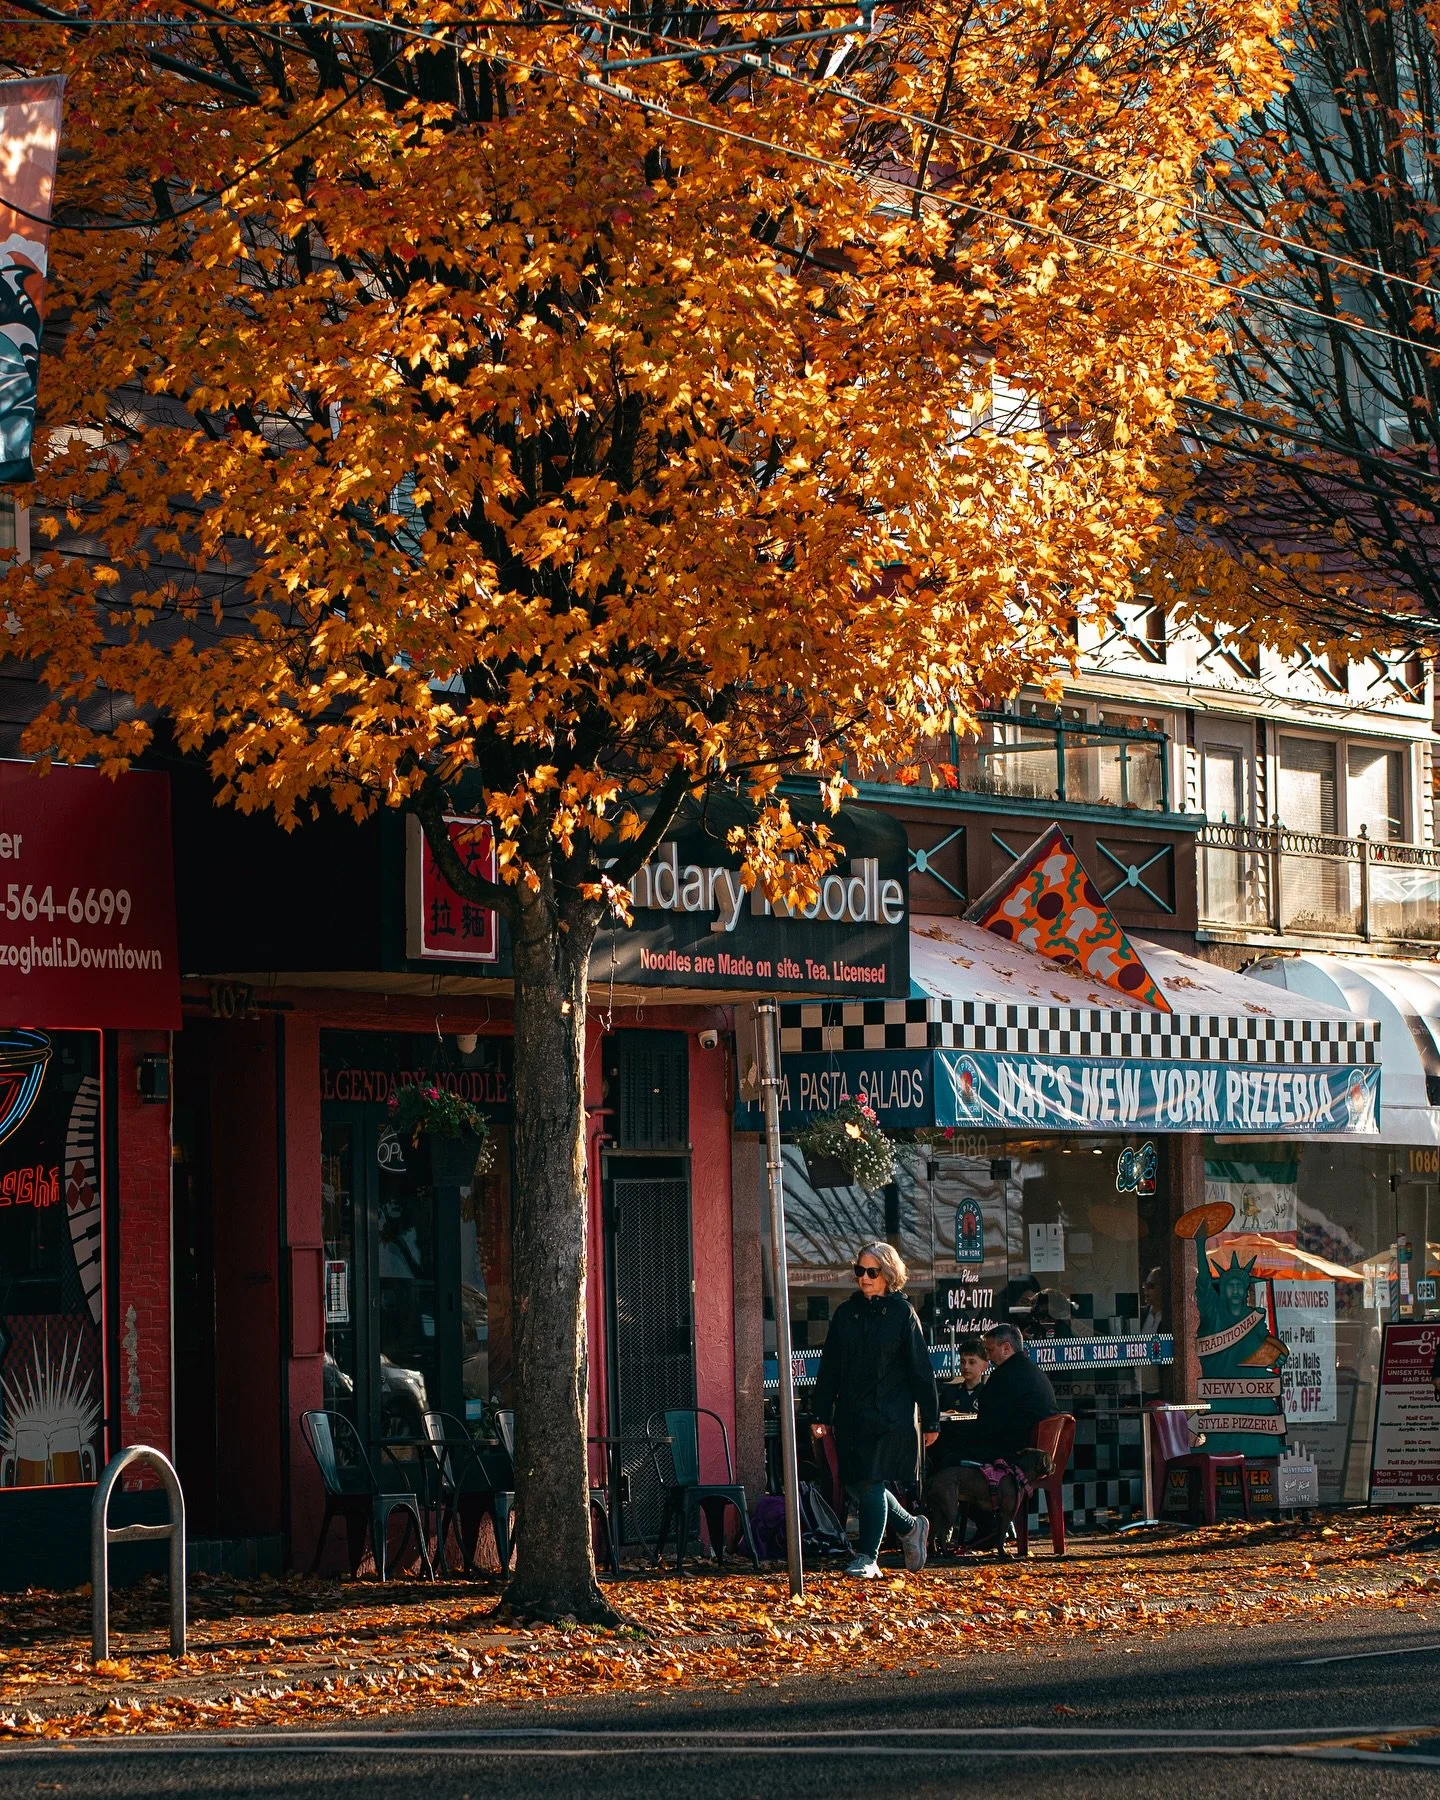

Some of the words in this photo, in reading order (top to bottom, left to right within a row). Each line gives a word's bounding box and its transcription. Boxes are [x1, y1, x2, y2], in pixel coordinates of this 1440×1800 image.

[640, 948, 691, 972] Noodles
[694, 956, 715, 974] are
[718, 954, 753, 977] Made
[756, 963, 771, 978] on
[777, 959, 803, 980] site.
[805, 959, 830, 981] Tea.
[833, 961, 885, 984] Licensed
[801, 1071, 848, 1111] PASTA
[859, 1068, 924, 1111] SALADS
[997, 1061, 1073, 1120] NAT'S
[1082, 1064, 1140, 1122] NEW
[1151, 1068, 1219, 1123] YORK
[1226, 1070, 1335, 1123] PIZZERIA
[1409, 1149, 1439, 1173] 1086
[962, 1269, 979, 1283] Phone
[948, 1289, 993, 1309] 642-0777
[1276, 1291, 1292, 1308] WAX
[1294, 1290, 1328, 1308] SERVICES
[1418, 1283, 1435, 1298] OPEN
[970, 1318, 981, 1332] End
[1199, 1314, 1257, 1353] TRADITIONAL
[1300, 1327, 1316, 1343] Pedi
[1036, 1348, 1056, 1363] PIZZA
[1064, 1346, 1084, 1361] PASTA
[1093, 1344, 1118, 1359] SALADS
[1126, 1343, 1147, 1357] HEROS
[1303, 1353, 1320, 1369] Nails
[1202, 1382, 1235, 1395] NEW
[1301, 1387, 1321, 1413] OFF
[1198, 1417, 1230, 1430] STYLE
[1232, 1417, 1278, 1431] PIZZERIA
